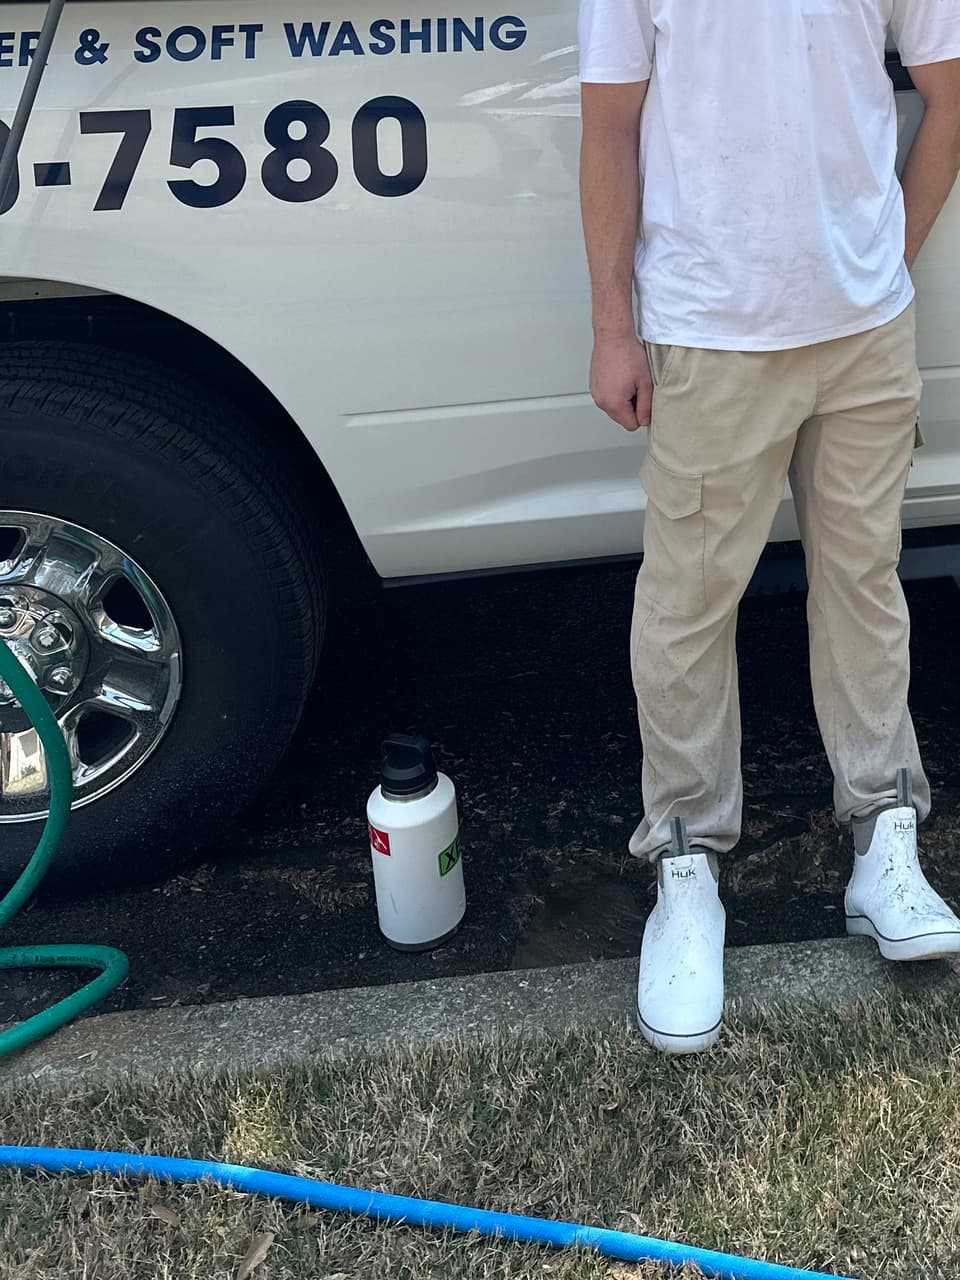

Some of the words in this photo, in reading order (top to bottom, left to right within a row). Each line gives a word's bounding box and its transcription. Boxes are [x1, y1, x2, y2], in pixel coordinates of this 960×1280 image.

[74, 28, 110, 65] &
[133, 23, 263, 63] SOFT
[283, 15, 528, 58] WASHING
[0, 95, 428, 215] -7580
[895, 821, 914, 830] Huk
[671, 868, 696, 878] Huk
